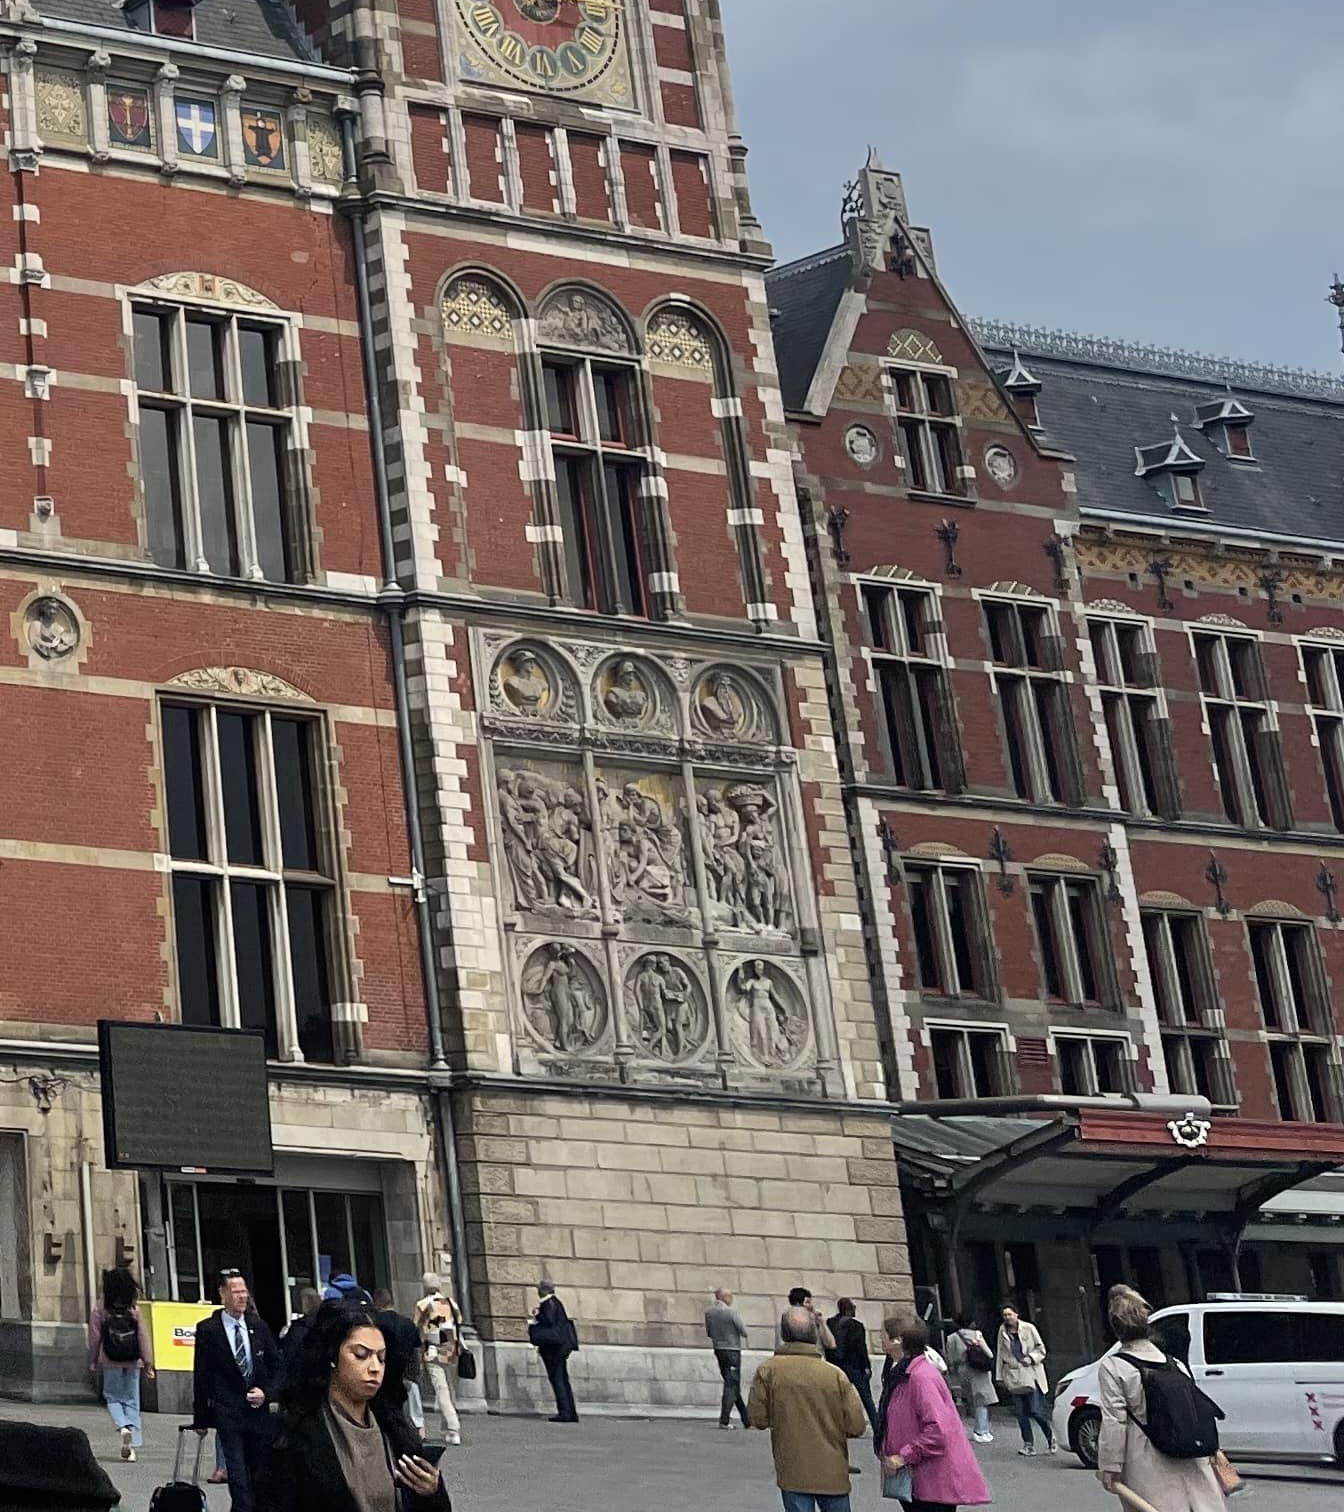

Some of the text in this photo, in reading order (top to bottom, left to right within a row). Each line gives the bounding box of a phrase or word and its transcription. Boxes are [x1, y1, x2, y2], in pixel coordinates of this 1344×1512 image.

[472, 7, 500, 38] VIII
[500, 39, 523, 65] VII
[536, 51, 555, 76] VI
[566, 49, 584, 73] V
